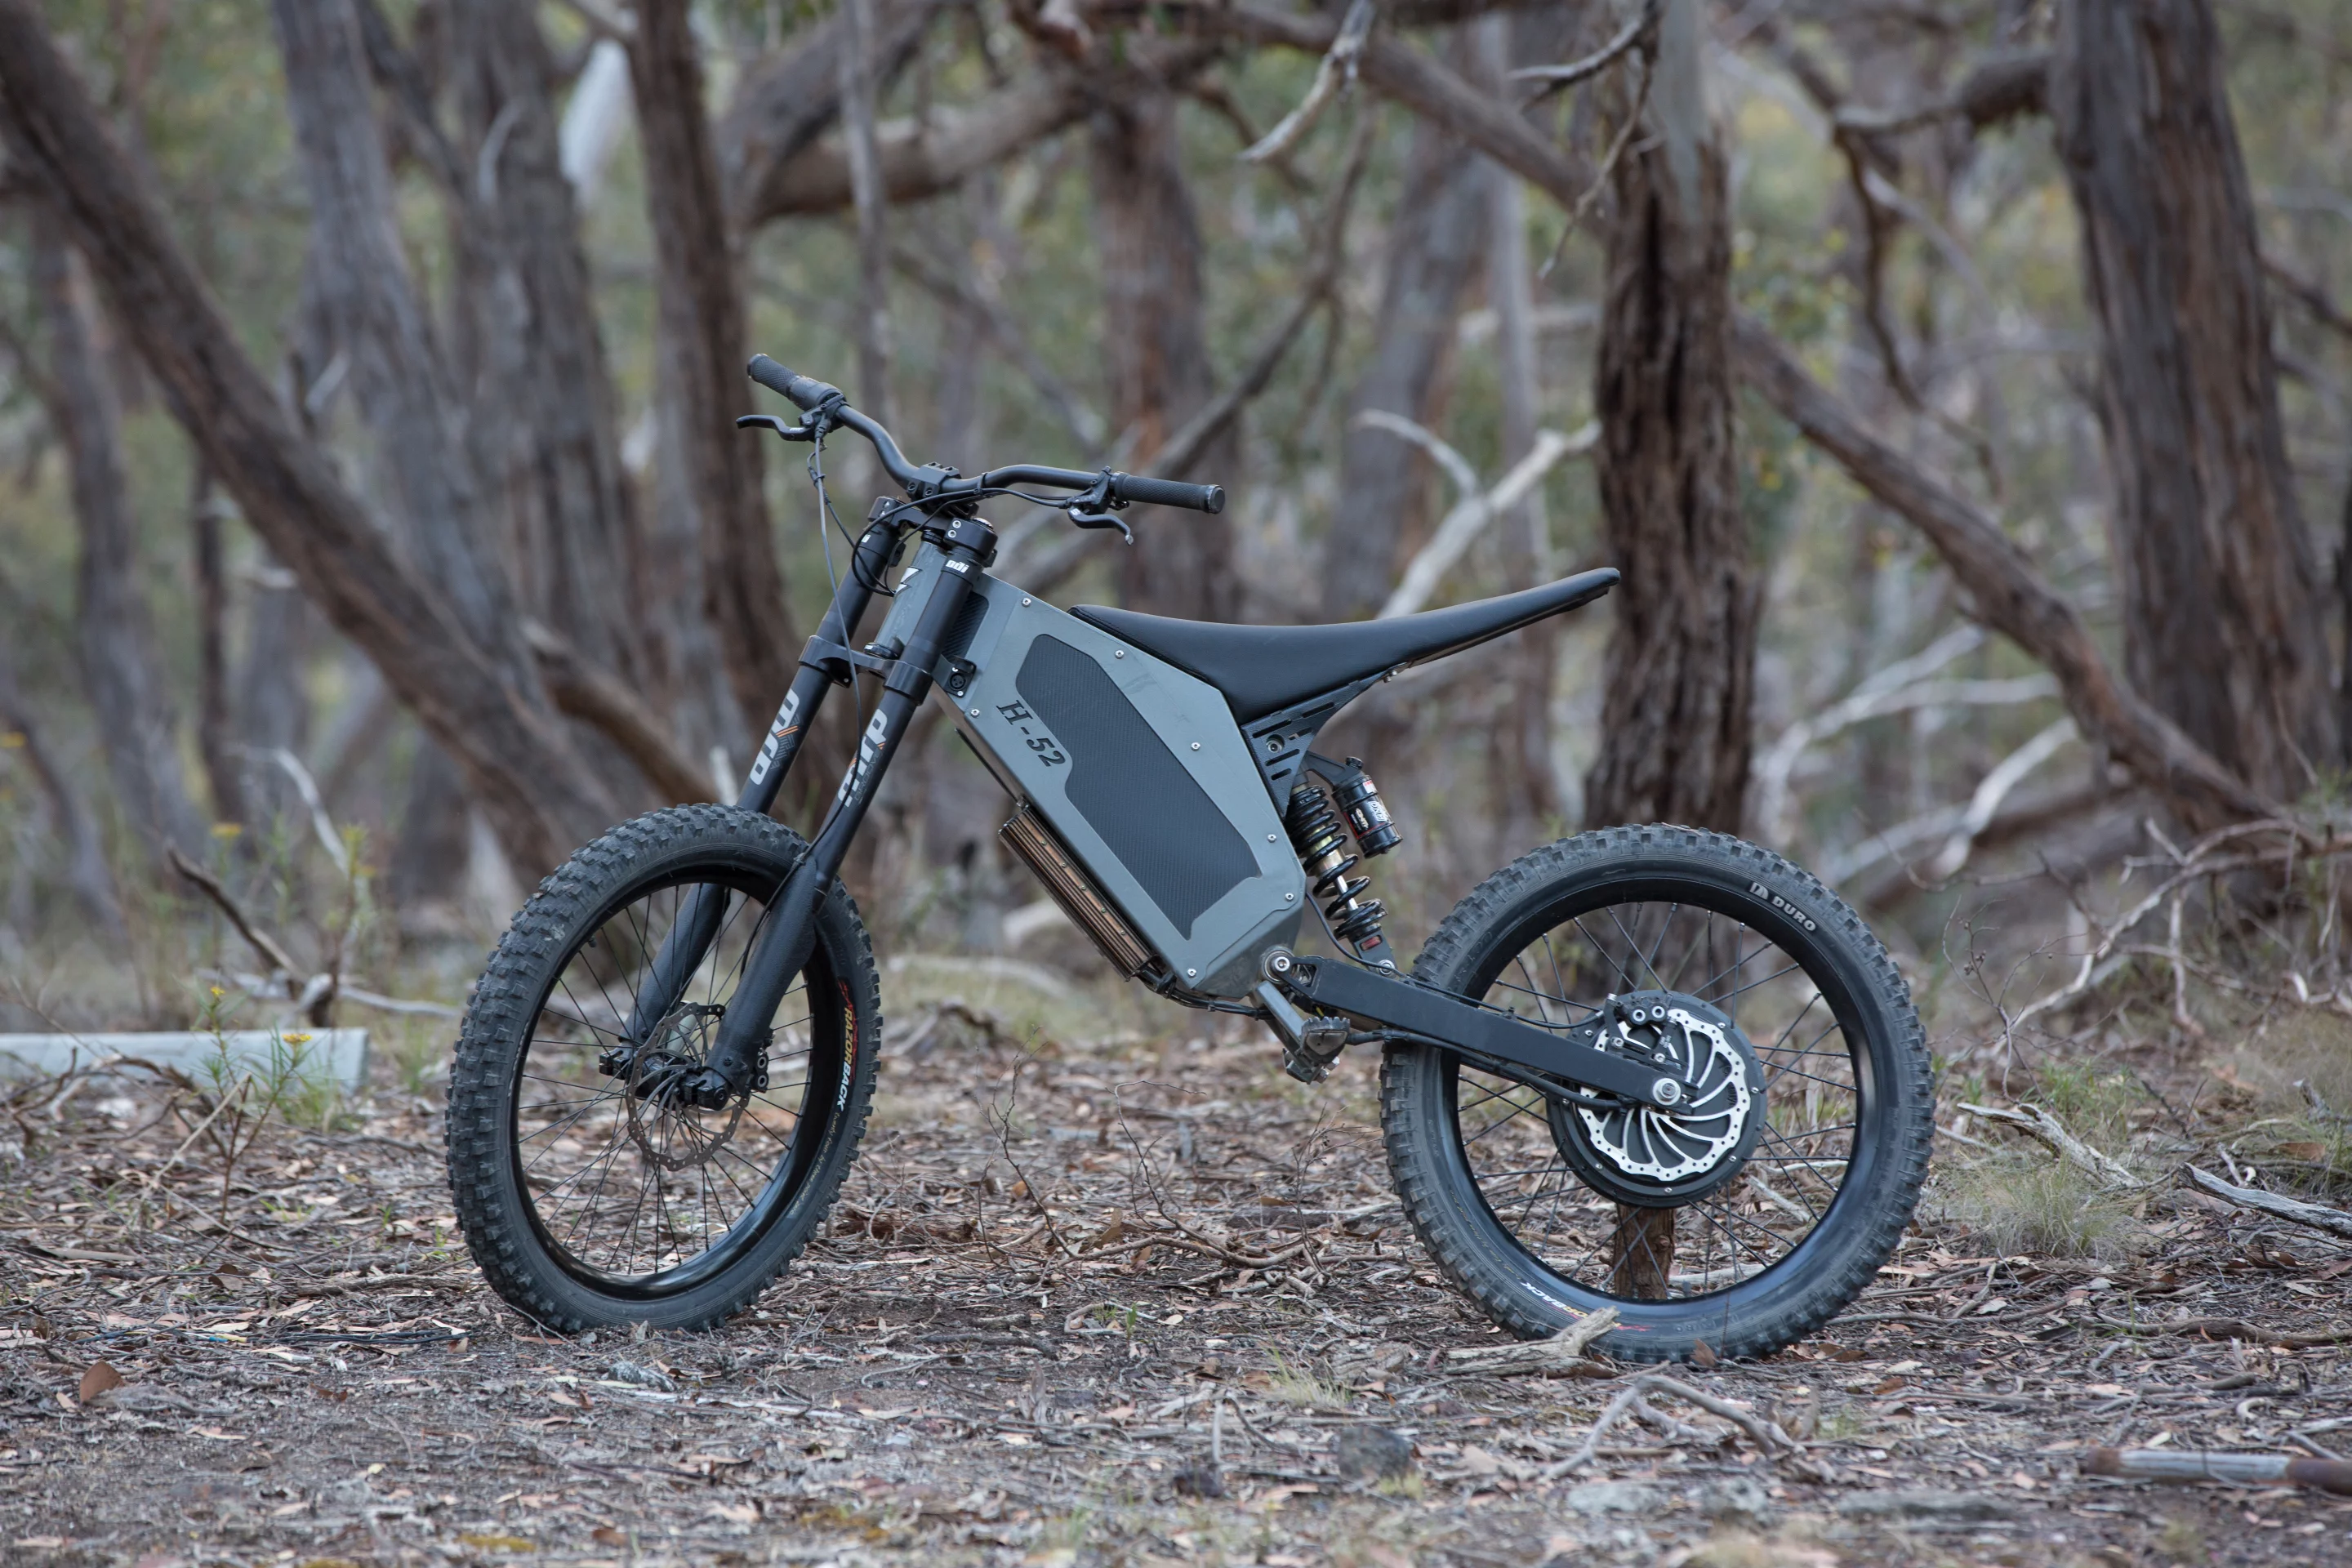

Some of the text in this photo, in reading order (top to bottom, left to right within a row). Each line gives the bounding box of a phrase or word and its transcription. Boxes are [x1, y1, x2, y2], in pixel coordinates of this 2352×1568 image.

[946, 559, 969, 573] odi
[750, 688, 800, 786] mrp
[837, 709, 888, 808] mrp
[996, 699, 1066, 767] H-52
[1771, 896, 1816, 931] DURO
[837, 1008, 853, 1111] RAZORBACK
